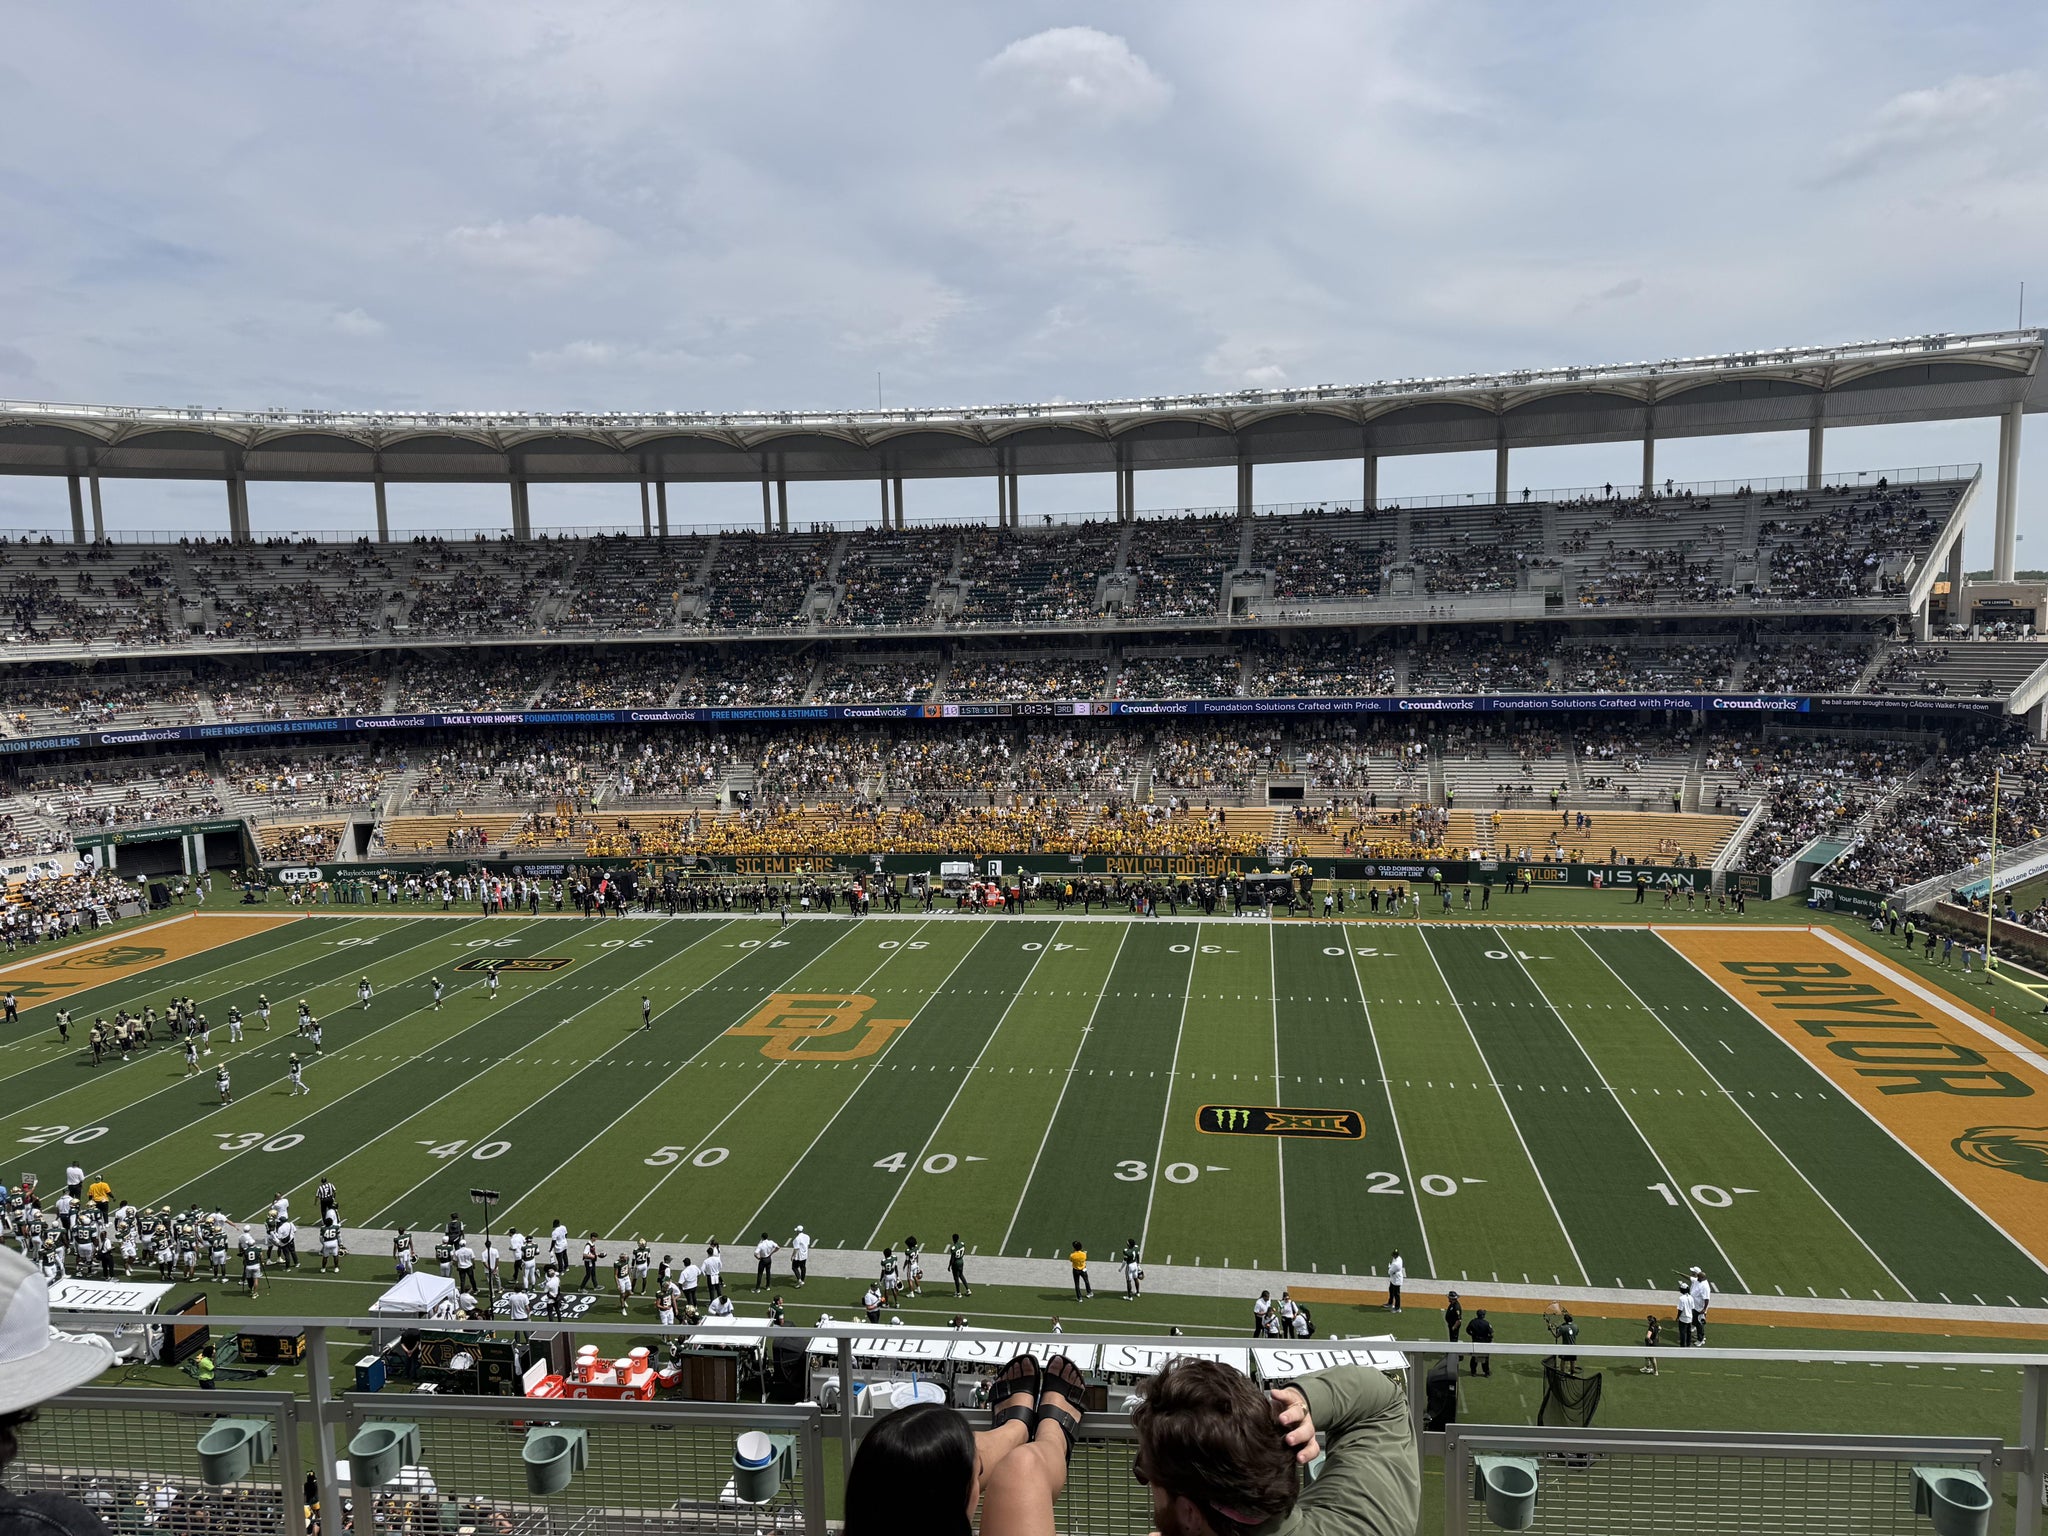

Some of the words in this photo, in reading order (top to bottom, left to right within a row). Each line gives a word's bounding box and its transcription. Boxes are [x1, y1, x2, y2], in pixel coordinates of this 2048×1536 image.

[1017, 704, 1049, 715] 10:31
[1079, 704, 1086, 714] 3
[1120, 703, 1188, 713] Groundworks
[1204, 703, 1253, 712] Foundation
[1255, 702, 1296, 711] Solutions
[1297, 701, 1331, 711] Crafted
[1333, 701, 1353, 710] with
[1355, 701, 1382, 710] Pride.
[1398, 699, 1475, 710] Groundworks
[1493, 699, 1548, 709] Foundation
[1550, 698, 1597, 708] Solutions
[1599, 698, 1637, 708] Crafted
[1639, 698, 1661, 707] with
[1663, 698, 1693, 708] Pride.
[1712, 698, 1797, 710] Groundworks
[1901, 701, 1908, 709] by
[631, 711, 696, 721] Groundworks
[711, 710, 730, 719] FREE
[730, 709, 781, 719] INSPECTIONS
[781, 710, 787, 718] &
[787, 709, 828, 719] ESTIMATES
[843, 708, 907, 718] Groundworks
[944, 706, 958, 715] 10
[355, 717, 425, 729] Groundworks
[442, 716, 471, 725] TACKLE
[472, 715, 494, 724] YOUR
[494, 714, 524, 723] HOME'S
[524, 713, 574, 723] FOUNDATION
[574, 713, 616, 723] PROBLEMS
[200, 726, 224, 737] FREE
[224, 722, 283, 736] INSPECTIONS
[283, 723, 291, 732] &
[291, 720, 338, 732] ESTIMATES
[29, 737, 81, 751] PROBLEMS
[101, 731, 181, 745] Groundworks
[735, 857, 761, 873] SIC
[789, 857, 833, 873] BEARS
[1106, 857, 1163, 874] BAYLOR
[1167, 857, 1245, 875] FOOTBALL
[1588, 869, 1694, 886] NISSAN
[2005, 873, 2028, 885] McLane
[1838, 895, 1853, 904] Your
[1852, 897, 1868, 905] Bank
[1720, 961, 2036, 1098] BAYLOR
[16, 1125, 109, 1145] 20
[218, 1132, 305, 1152] 30
[426, 1139, 512, 1160] 40
[643, 1145, 730, 1167] 50
[872, 1151, 959, 1174] 40
[1113, 1160, 1199, 1184] 30
[1364, 1171, 1459, 1197] 20
[1646, 1182, 1734, 1208] 10
[323, 1229, 336, 1239] 46
[398, 1238, 410, 1248] 97
[248, 1251, 256, 1261] 8
[637, 1252, 648, 1261] 20
[51, 1285, 144, 1307] STIFEL
